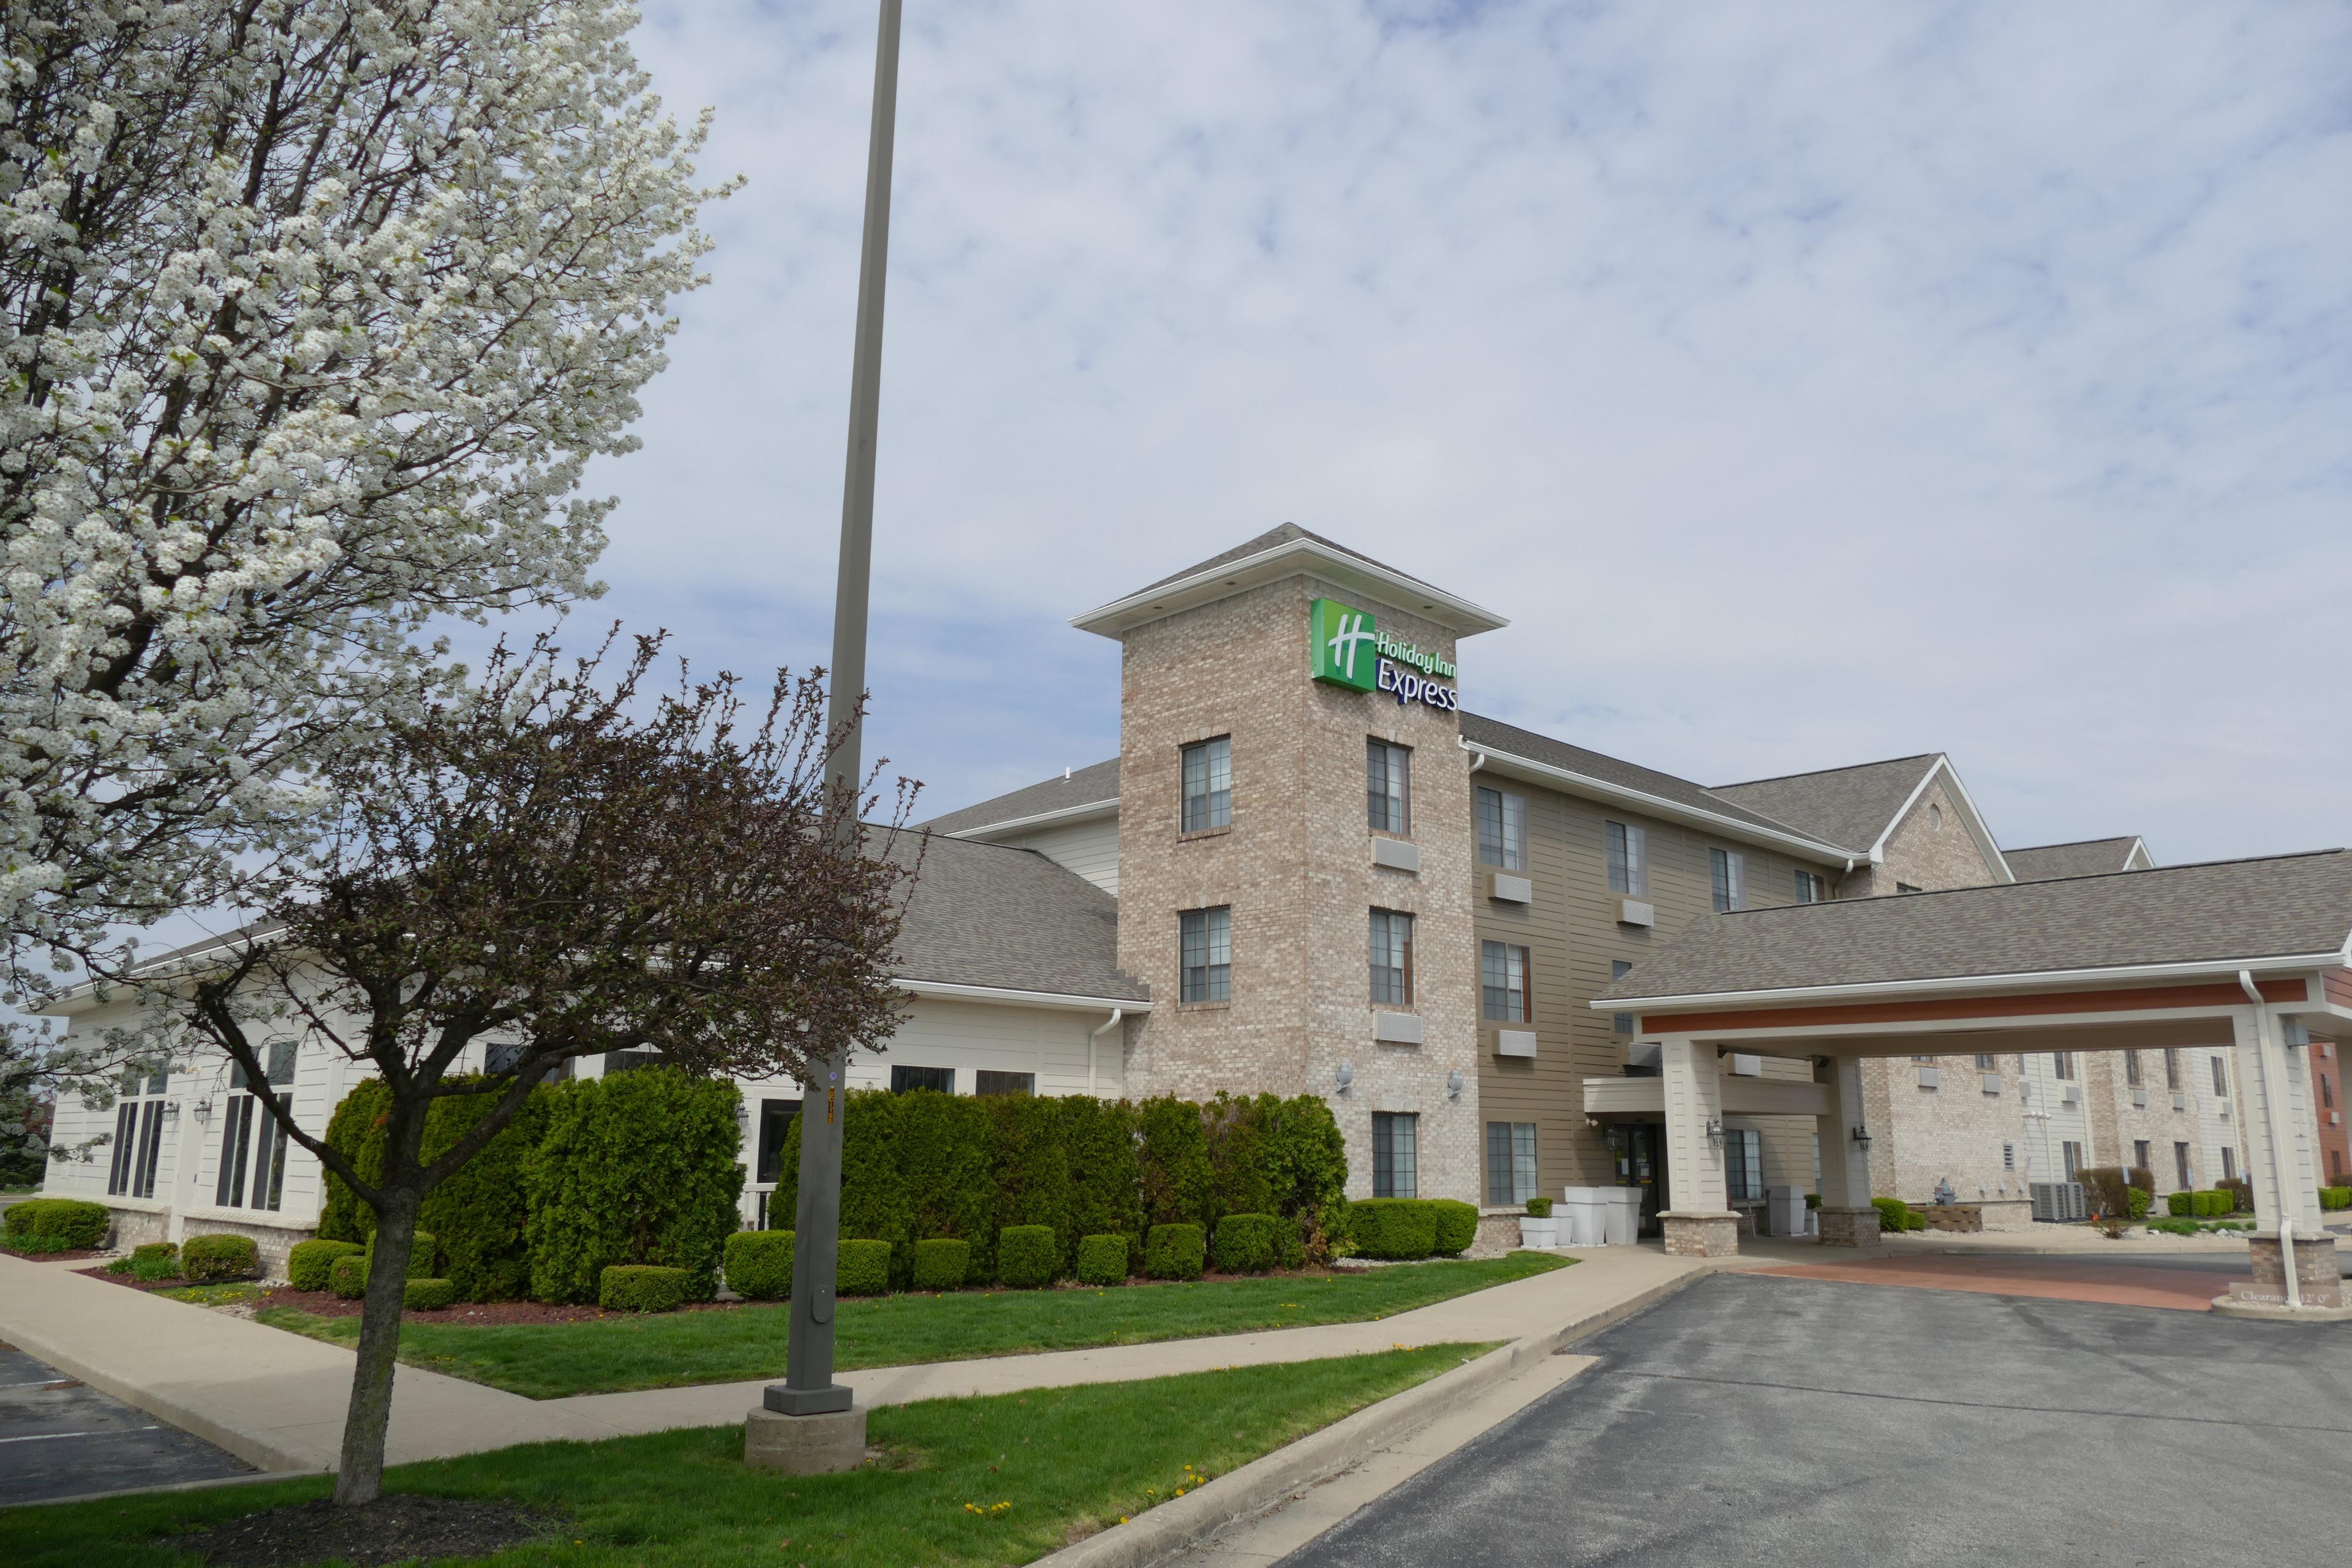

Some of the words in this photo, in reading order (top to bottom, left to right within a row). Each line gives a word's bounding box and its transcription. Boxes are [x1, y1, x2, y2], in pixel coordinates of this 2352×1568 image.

[1328, 614, 1375, 679] H
[1377, 631, 1433, 674] Holiday
[1435, 652, 1457, 678] Inn
[1378, 658, 1457, 710] Express
